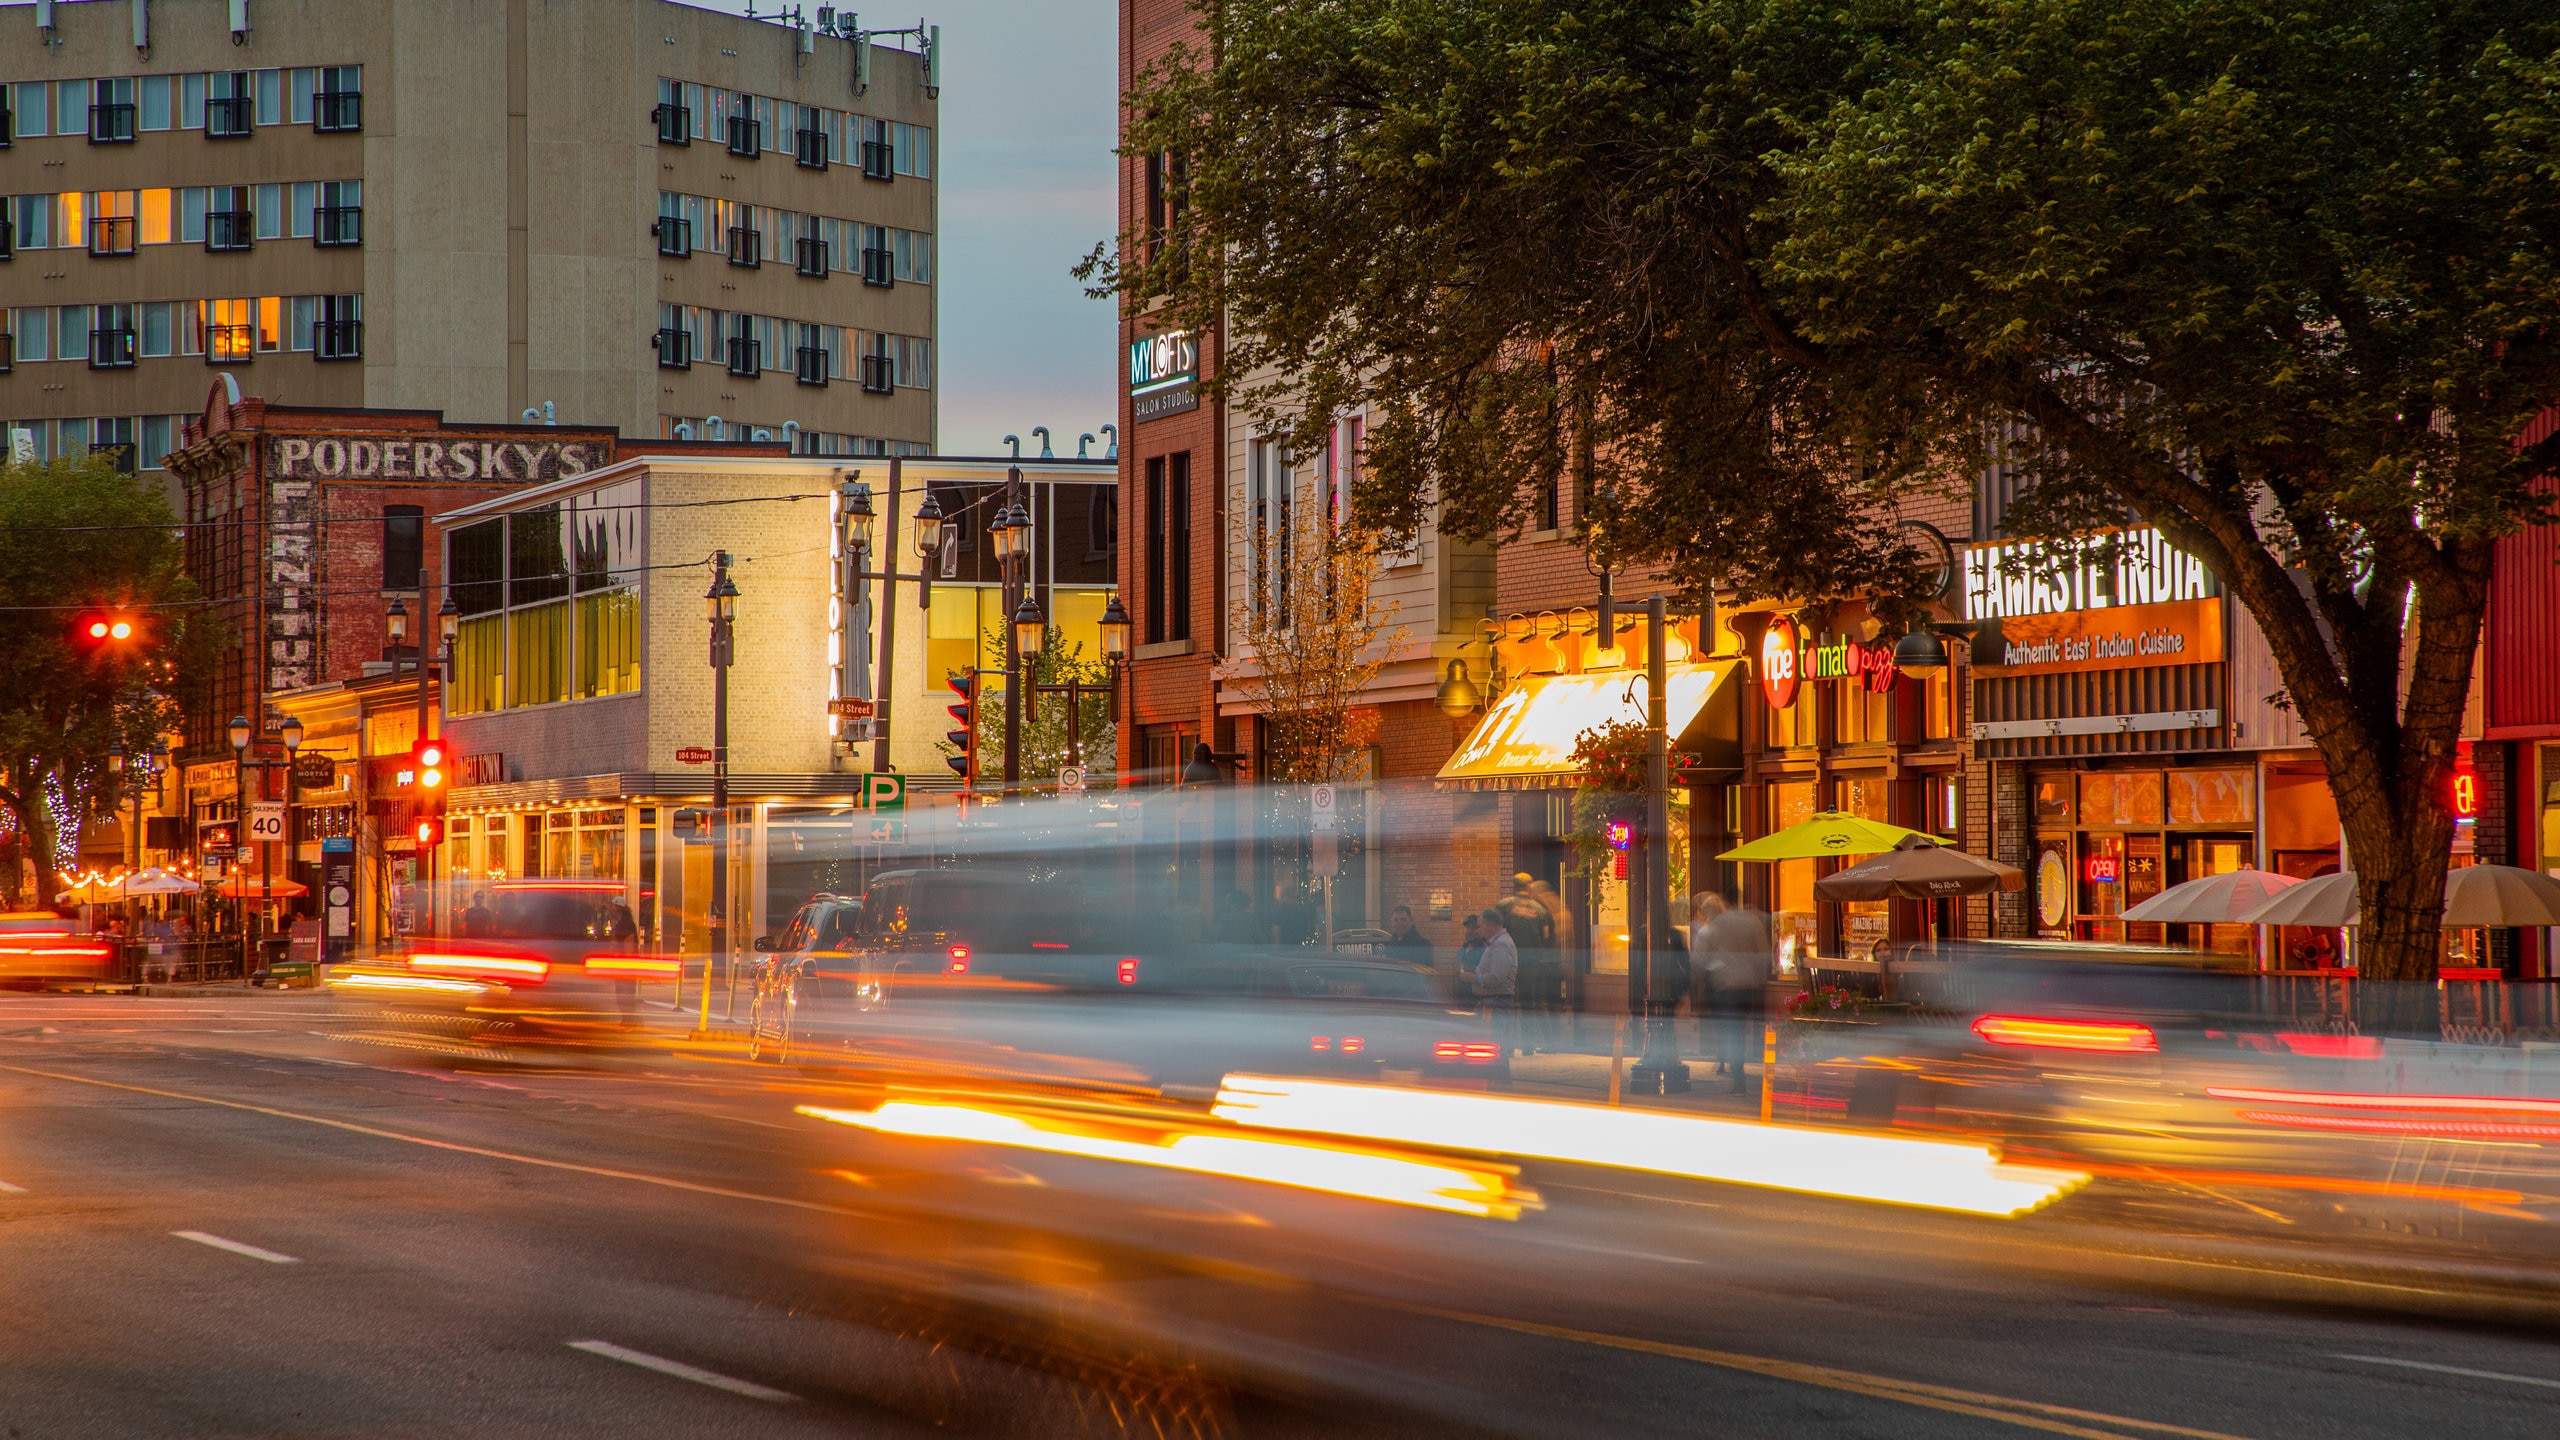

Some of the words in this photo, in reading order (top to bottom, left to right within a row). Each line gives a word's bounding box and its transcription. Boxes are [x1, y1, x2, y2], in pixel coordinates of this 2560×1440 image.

[1136, 396, 1160, 417] SALON
[1163, 389, 1195, 410] STUDIOS
[280, 438, 586, 479] PODERSKY'S
[1965, 534, 2108, 621] NAMASTE
[2116, 528, 2206, 606] INDIA
[2004, 636, 2061, 666] Authentic
[2065, 633, 2092, 661] East
[2095, 631, 2135, 658] Indian
[2138, 627, 2184, 656] Cuisine
[1860, 648, 1896, 694] pizz
[831, 703, 845, 713] 104
[846, 704, 870, 714] Street
[678, 751, 689, 760] 104
[690, 751, 710, 760] Street
[869, 776, 900, 816] P
[252, 817, 281, 835] 40
[2089, 859, 2115, 879] OPEN
[1336, 943, 1373, 956] SUMMER
